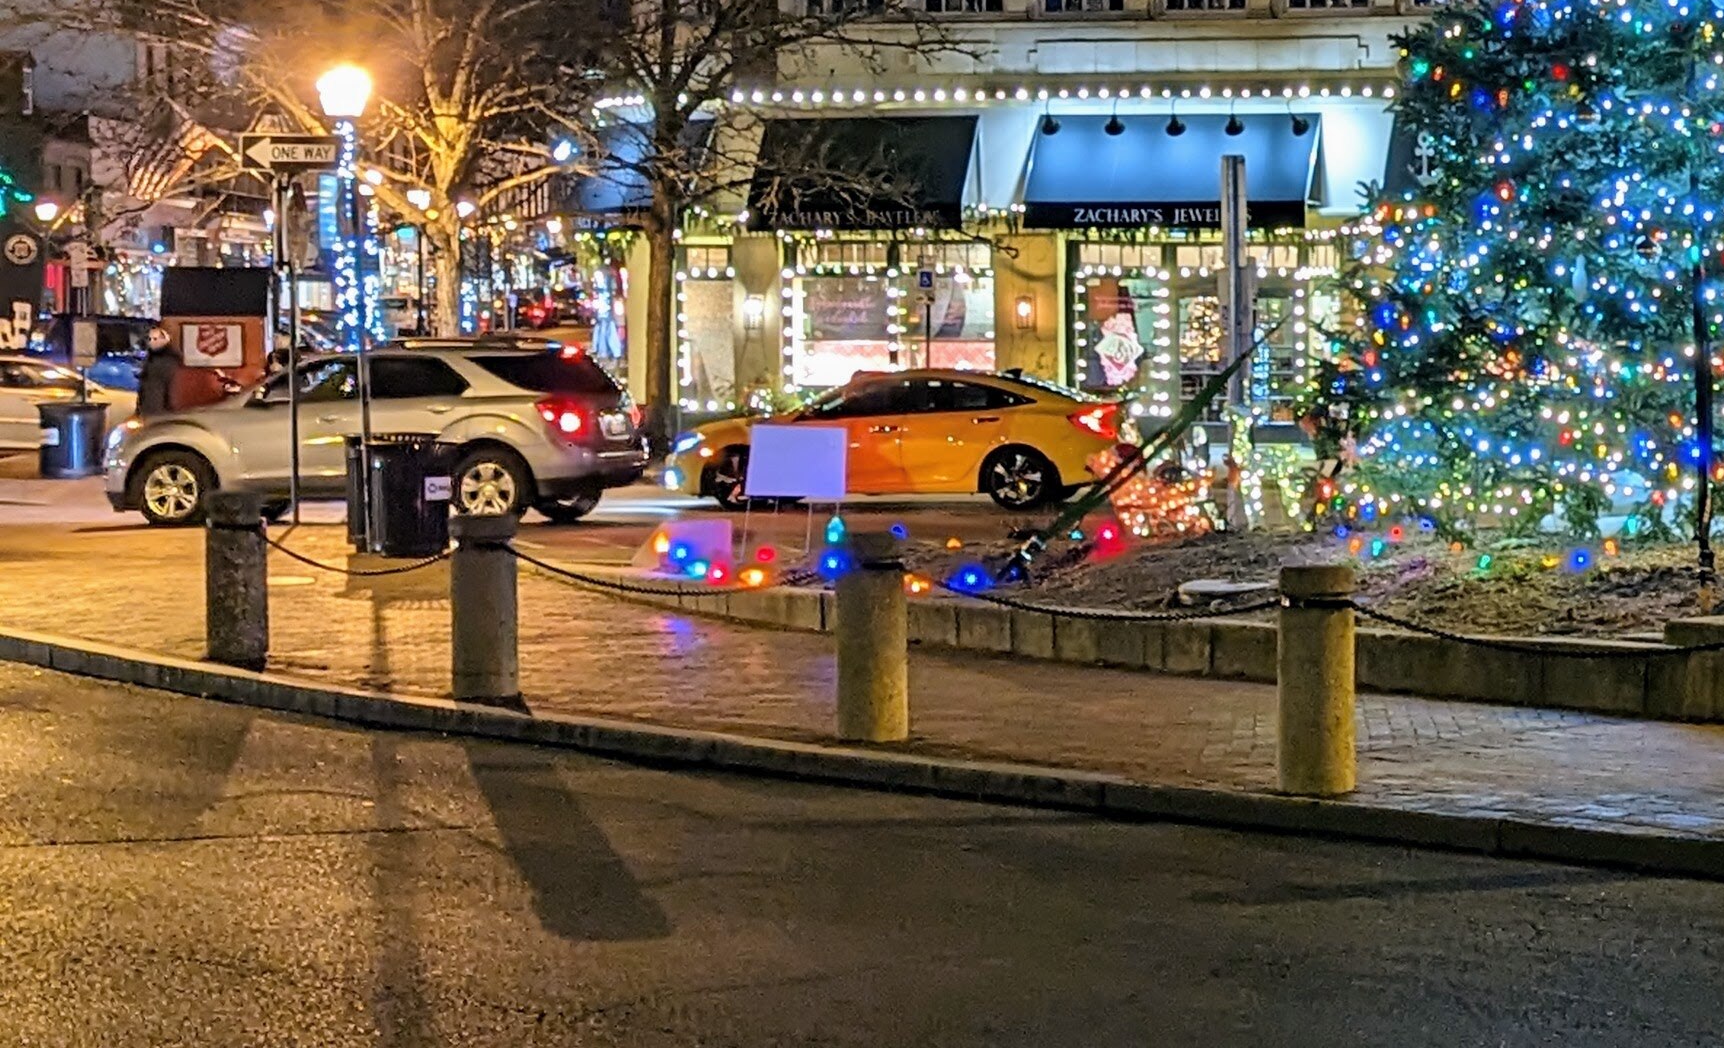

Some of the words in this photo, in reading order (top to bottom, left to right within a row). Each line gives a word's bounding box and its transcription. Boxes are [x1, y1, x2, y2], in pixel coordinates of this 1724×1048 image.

[271, 146, 299, 160] ONE
[303, 146, 331, 160] WAY
[1073, 208, 1164, 224] ZACHARY'S
